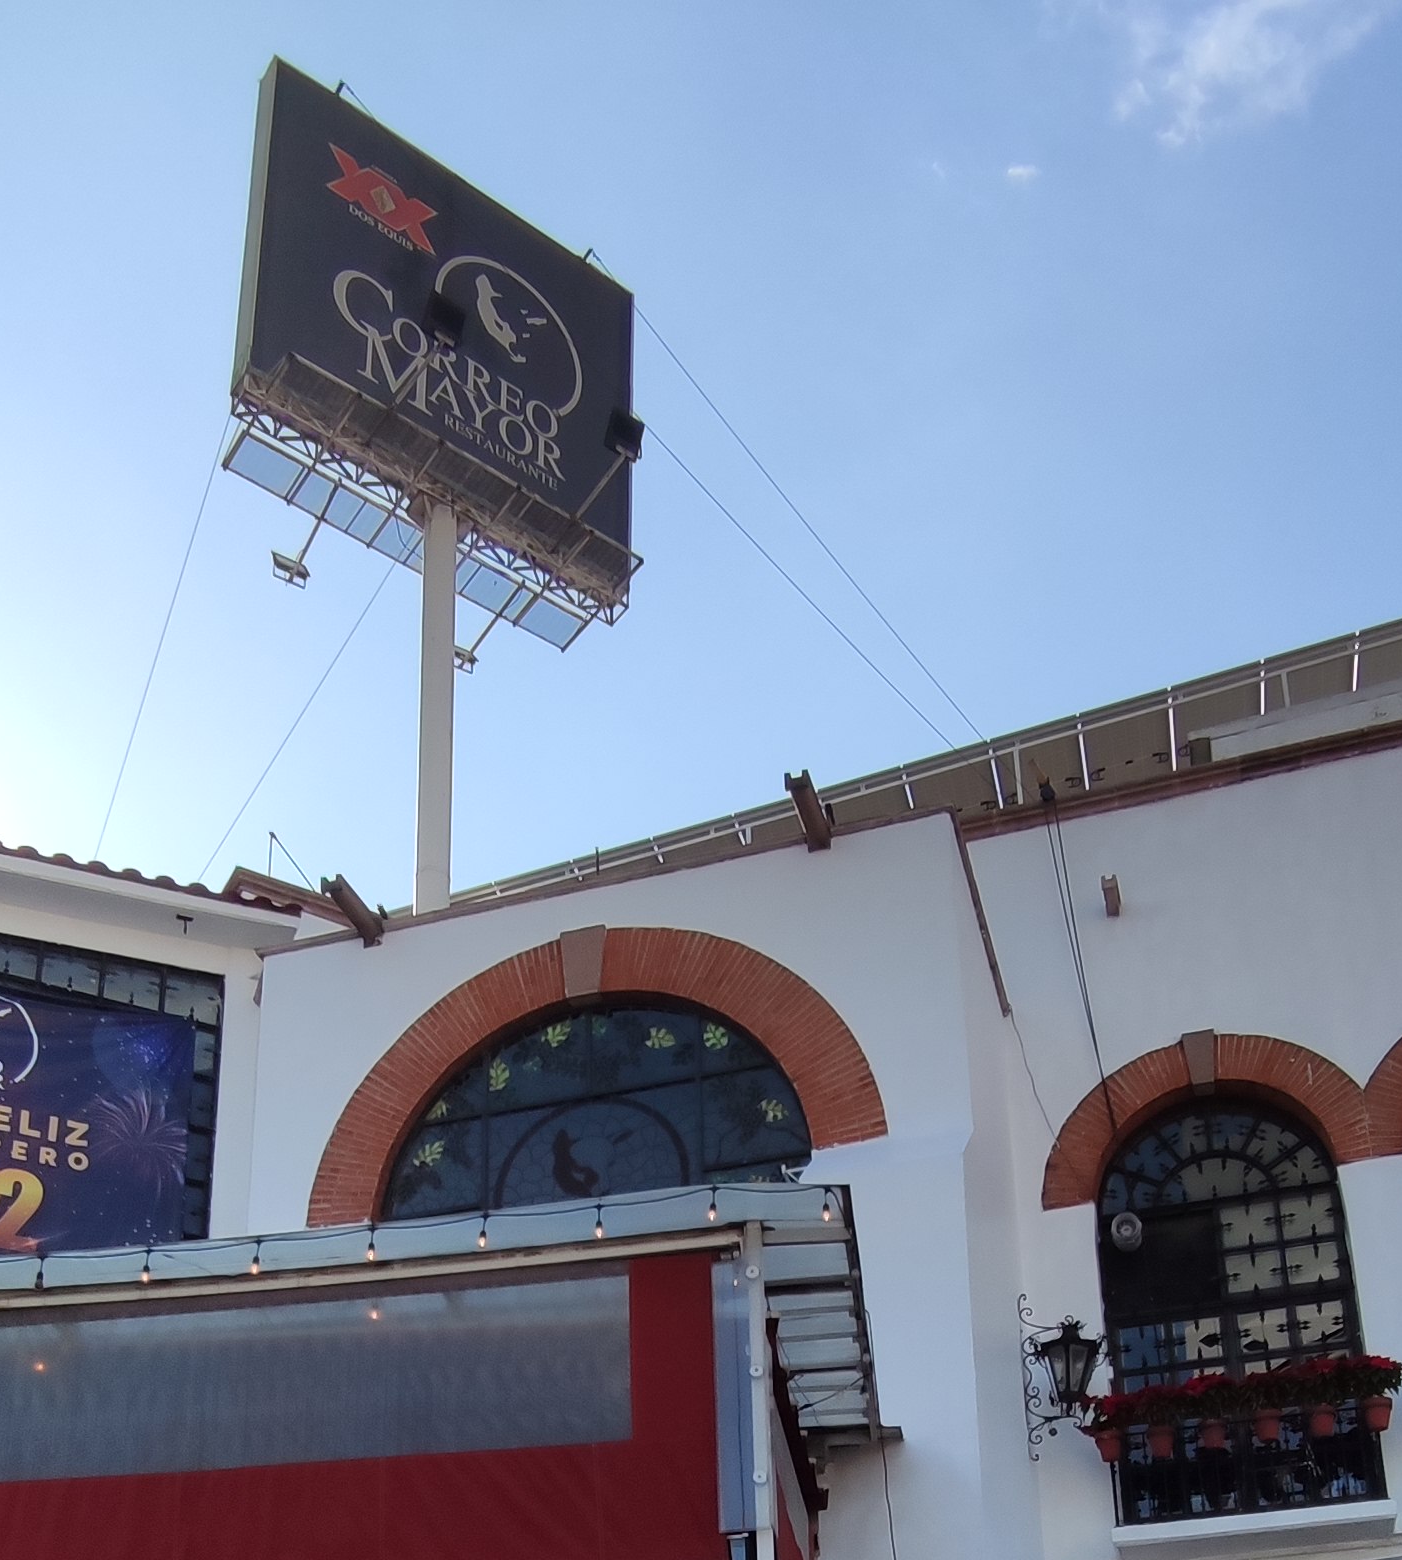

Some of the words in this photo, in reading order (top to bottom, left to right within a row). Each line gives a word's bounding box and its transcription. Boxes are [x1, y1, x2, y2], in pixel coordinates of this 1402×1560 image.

[349, 204, 375, 226] DOS
[378, 222, 414, 251] EQUIS
[333, 270, 558, 438] CORREO
[357, 320, 566, 481] MAYOR
[444, 414, 558, 490] RESTAURANTE
